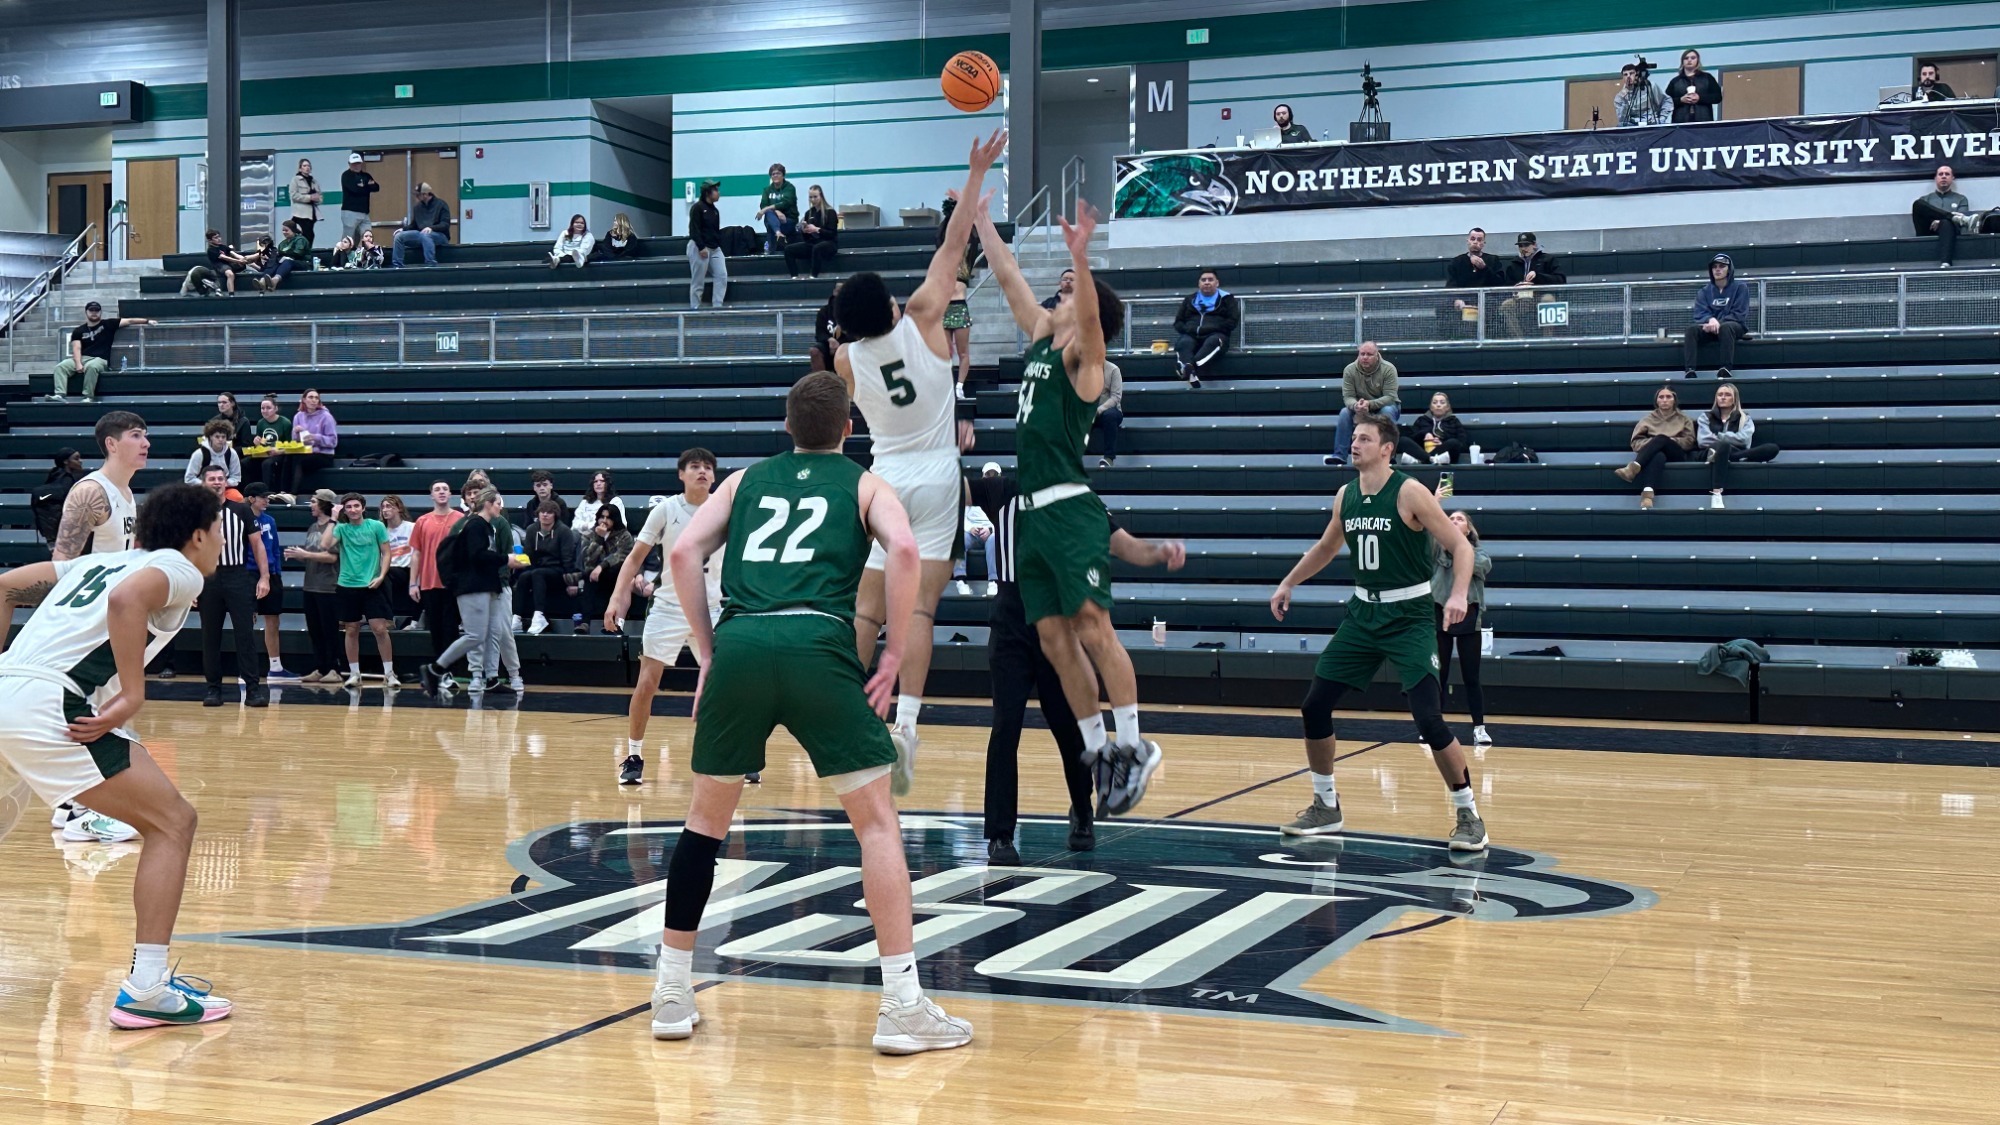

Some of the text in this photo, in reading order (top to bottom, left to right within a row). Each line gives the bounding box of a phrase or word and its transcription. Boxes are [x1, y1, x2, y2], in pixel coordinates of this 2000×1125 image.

[0, 74, 21, 89] KS
[954, 59, 979, 79] NCAA
[1148, 80, 1173, 112] M
[1244, 158, 1518, 195] NORTHEASTERN
[1528, 151, 1638, 180] STATE
[1649, 138, 1880, 174] UNIVERSITY
[1540, 306, 1566, 324] 105
[438, 336, 457, 350] 104
[879, 358, 917, 408] 5
[742, 495, 828, 563] 22
[1345, 516, 1392, 532] BEARCATS
[1357, 534, 1380, 570] 10
[54, 564, 127, 608] 15
[1190, 987, 1260, 1004] TM
